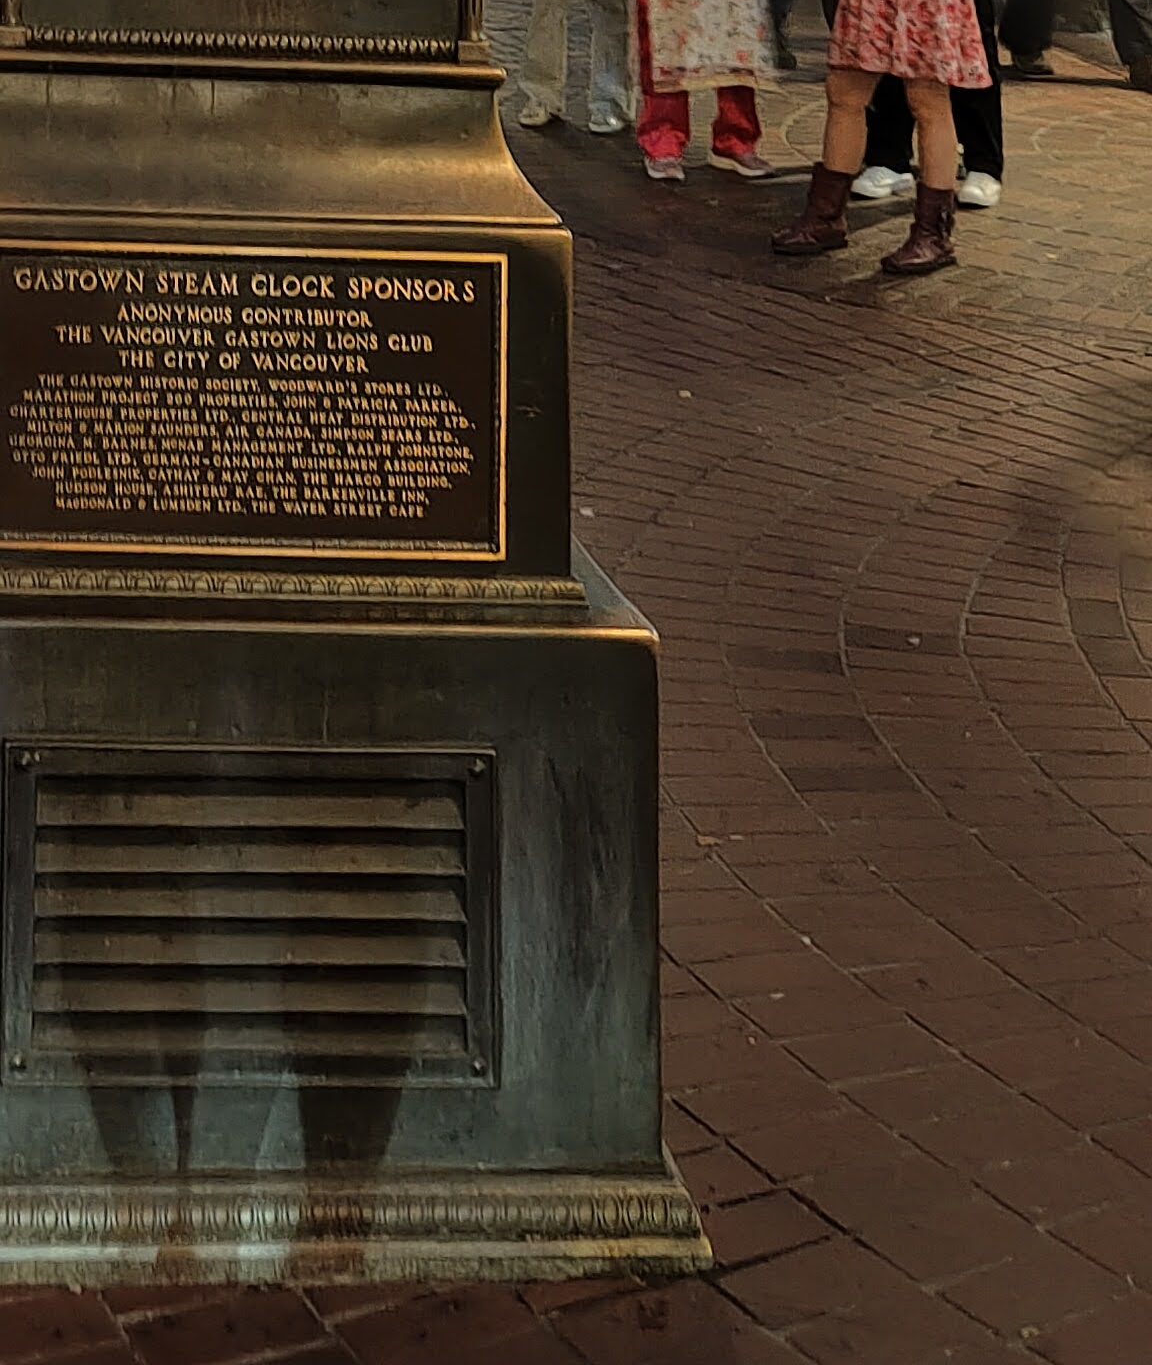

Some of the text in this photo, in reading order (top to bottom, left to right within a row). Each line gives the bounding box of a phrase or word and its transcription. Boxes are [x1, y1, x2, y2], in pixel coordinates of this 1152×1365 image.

[14, 267, 476, 303] GASTOWN STEAM CLOCK SPONSORS
[117, 302, 374, 328] ANONYMOUS CONTRIBUTOR
[55, 324, 434, 353] THE VANCOUVER GASTOWN LIONS CLUB
[119, 349, 370, 374] THE CITY OF VANCOUVER
[38, 374, 65, 387] THE
[70, 374, 134, 389] GASTOWN
[140, 375, 200, 390] HISTORIC
[269, 379, 358, 395] WOODWARD'S
[364, 381, 411, 397] STORES
[23, 389, 95, 403] MARATHON
[102, 390, 159, 404] PROJECT
[283, 395, 318, 409] JOHN
[338, 397, 398, 412] PATRICIA
[10, 404, 114, 419] CHARTERHOUSE
[120, 406, 198, 421] PROPERTIES
[242, 410, 304, 425] CENTRAL
[310, 411, 344, 426] HEAT
[351, 412, 438, 429] DISTRIBUTION
[27, 420, 73, 434] MILTON
[94, 422, 145, 436] MARION
[225, 424, 249, 438] AIR
[321, 426, 375, 442] SIMPSON
[381, 427, 423, 443] SEARS
[212, 439, 304, 455] MANAGEMENT
[347, 442, 392, 458] RALPH
[13, 450, 46, 463] OTTO
[292, 456, 379, 472] BUSINESSMEN
[33, 466, 65, 479] JOHN
[149, 468, 200, 483] CATHAY
[222, 470, 248, 484] MAY
[303, 472, 328, 486] THE
[56, 481, 107, 495] HUDSON
[272, 486, 297, 500] THE
[304, 487, 395, 503] BARKERVILLE
[153, 498, 211, 513] LUMSDEN
[252, 500, 277, 514] THE
[284, 501, 327, 516] WATER
[334, 502, 383, 517] STREET
